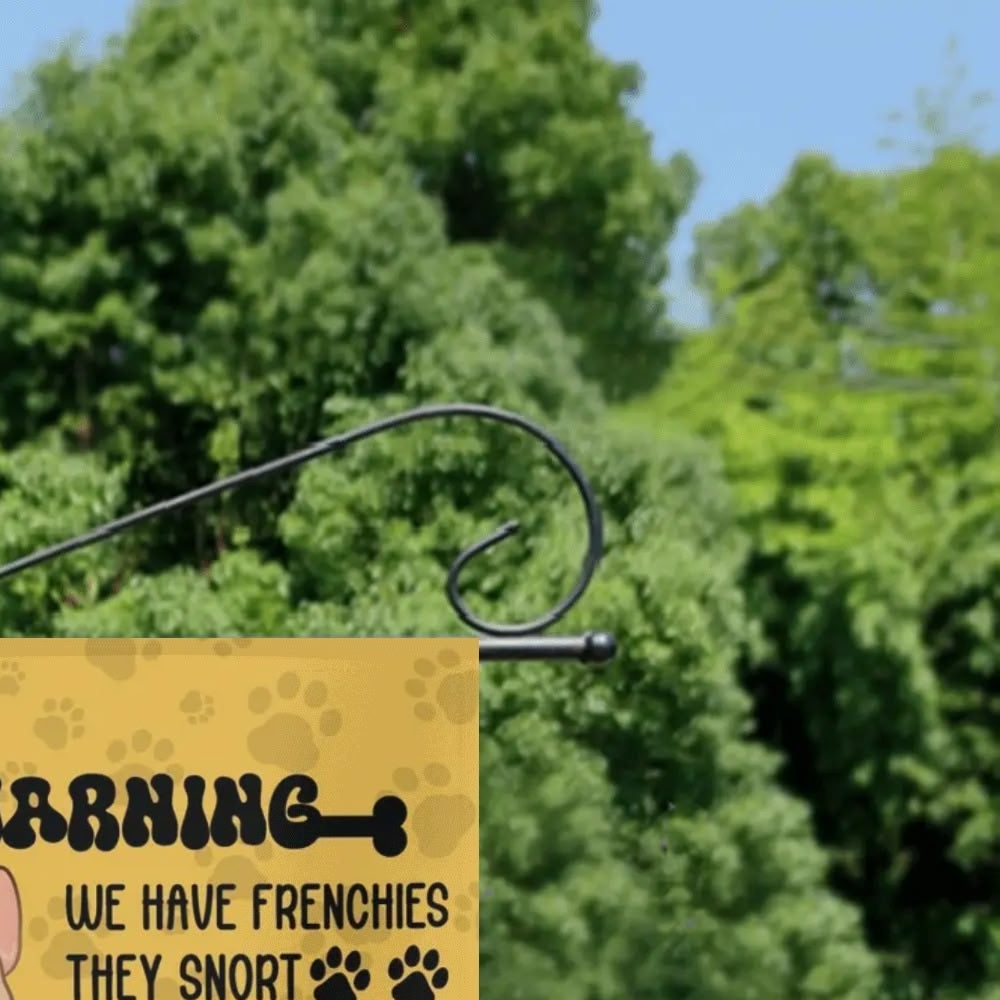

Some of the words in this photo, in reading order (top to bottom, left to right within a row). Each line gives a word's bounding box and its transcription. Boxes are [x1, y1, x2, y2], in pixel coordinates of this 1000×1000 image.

[65, 883, 126, 931] WE
[142, 883, 236, 930] HAVE
[252, 882, 449, 930] FRENCHIES
